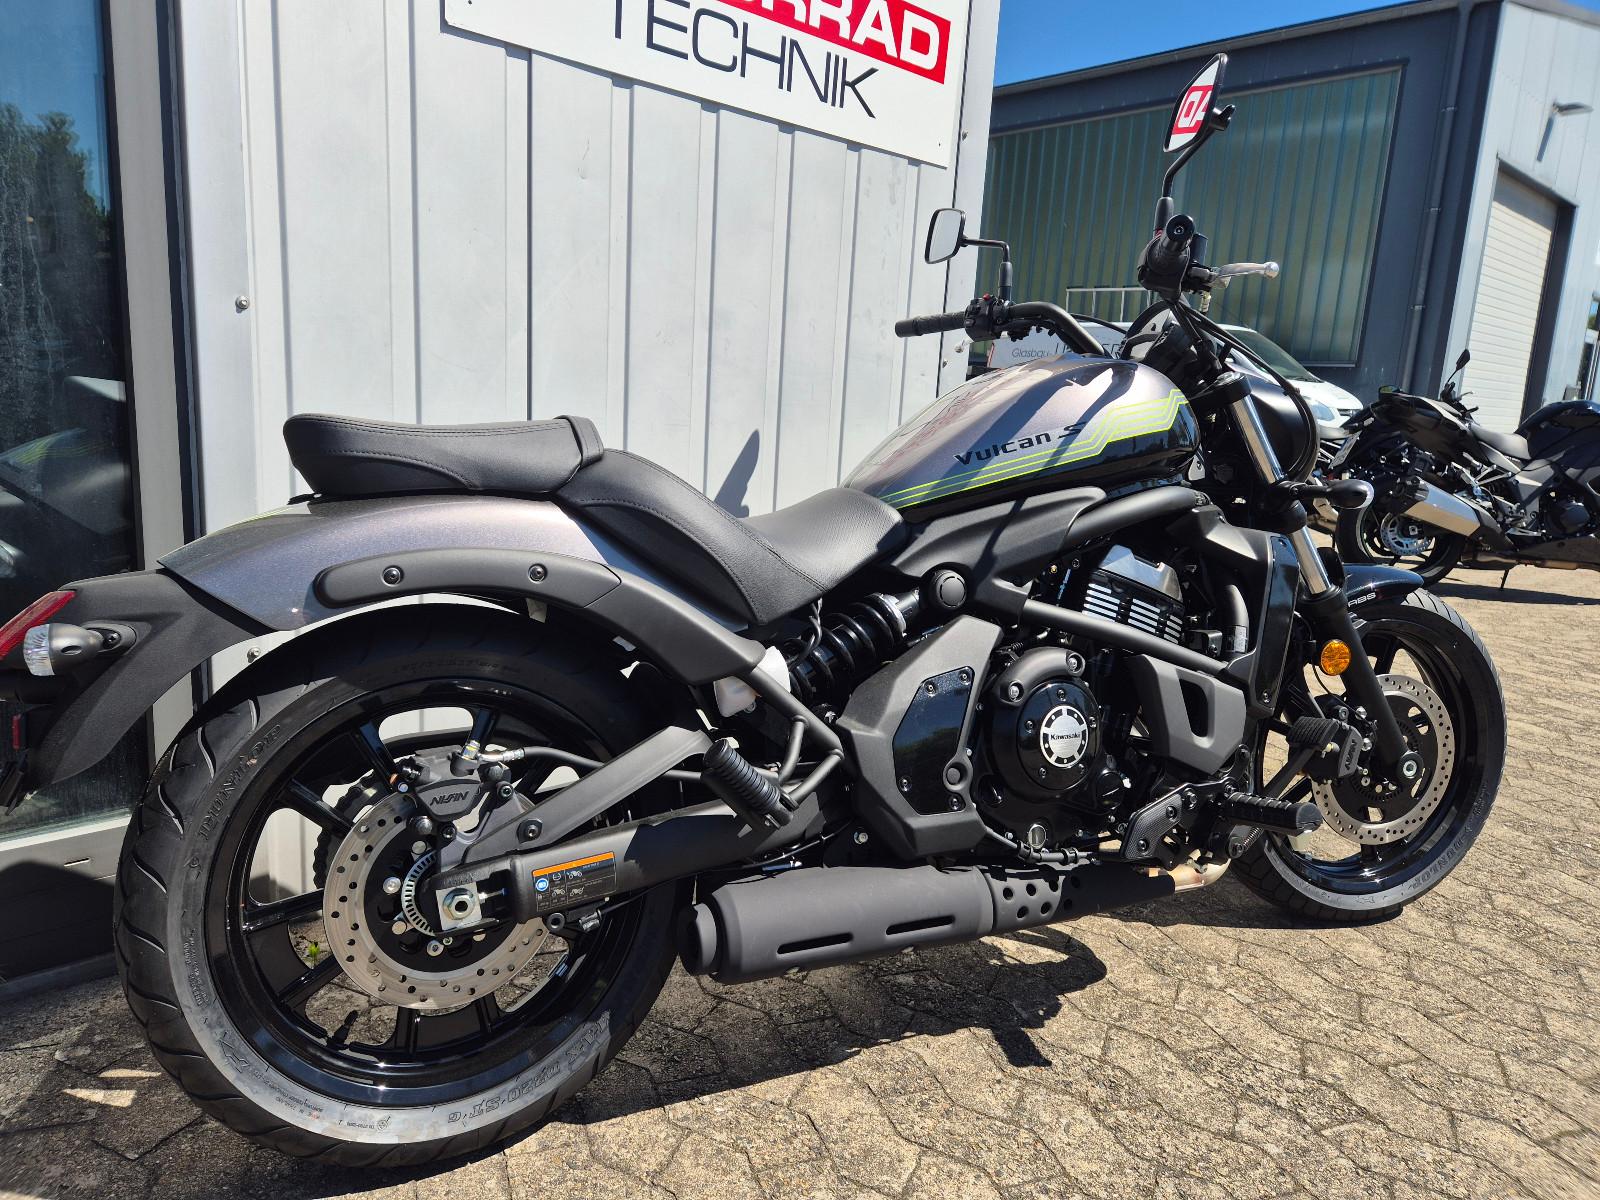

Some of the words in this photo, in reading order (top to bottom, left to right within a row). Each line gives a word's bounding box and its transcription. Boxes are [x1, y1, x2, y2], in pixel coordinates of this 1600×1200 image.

[743, 0, 941, 71] RAD
[1347, 592, 1377, 608] ABS
[1050, 732, 1081, 741] Kawasaki
